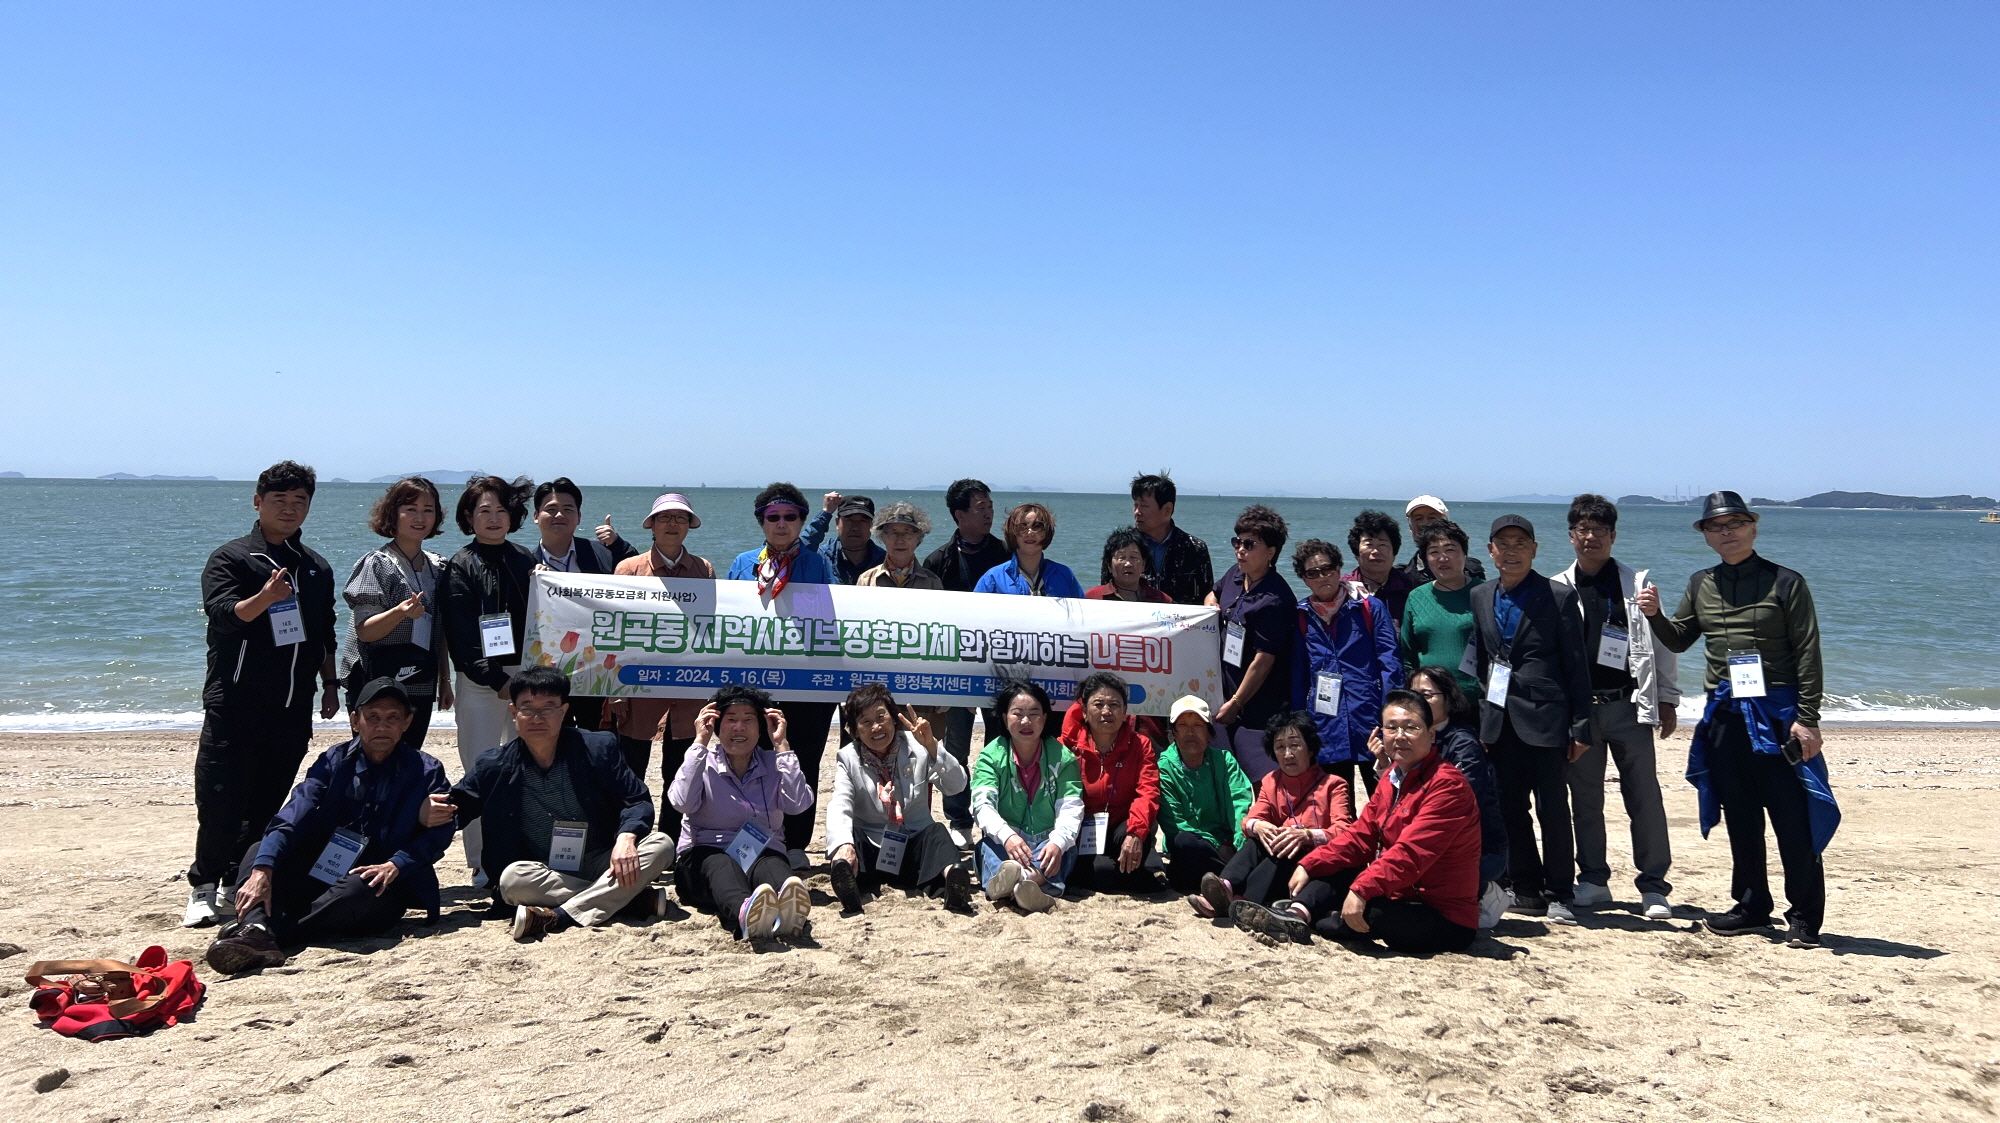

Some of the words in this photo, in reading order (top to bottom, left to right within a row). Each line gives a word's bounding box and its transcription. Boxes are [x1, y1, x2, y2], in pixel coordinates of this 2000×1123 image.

[651, 591, 698, 603] 지원사업>
[591, 610, 689, 653] 원곡동
[989, 628, 1089, 669] 함께하는
[1090, 632, 1173, 674] 나들이
[400, 665, 417, 675] NIKE
[637, 669, 662, 682] 일자
[675, 668, 714, 684] 2024.
[720, 670, 733, 684] 5.
[740, 670, 786, 686] 16.(목)
[811, 673, 835, 687] 주관
[894, 674, 972, 693] 행정복지센터
